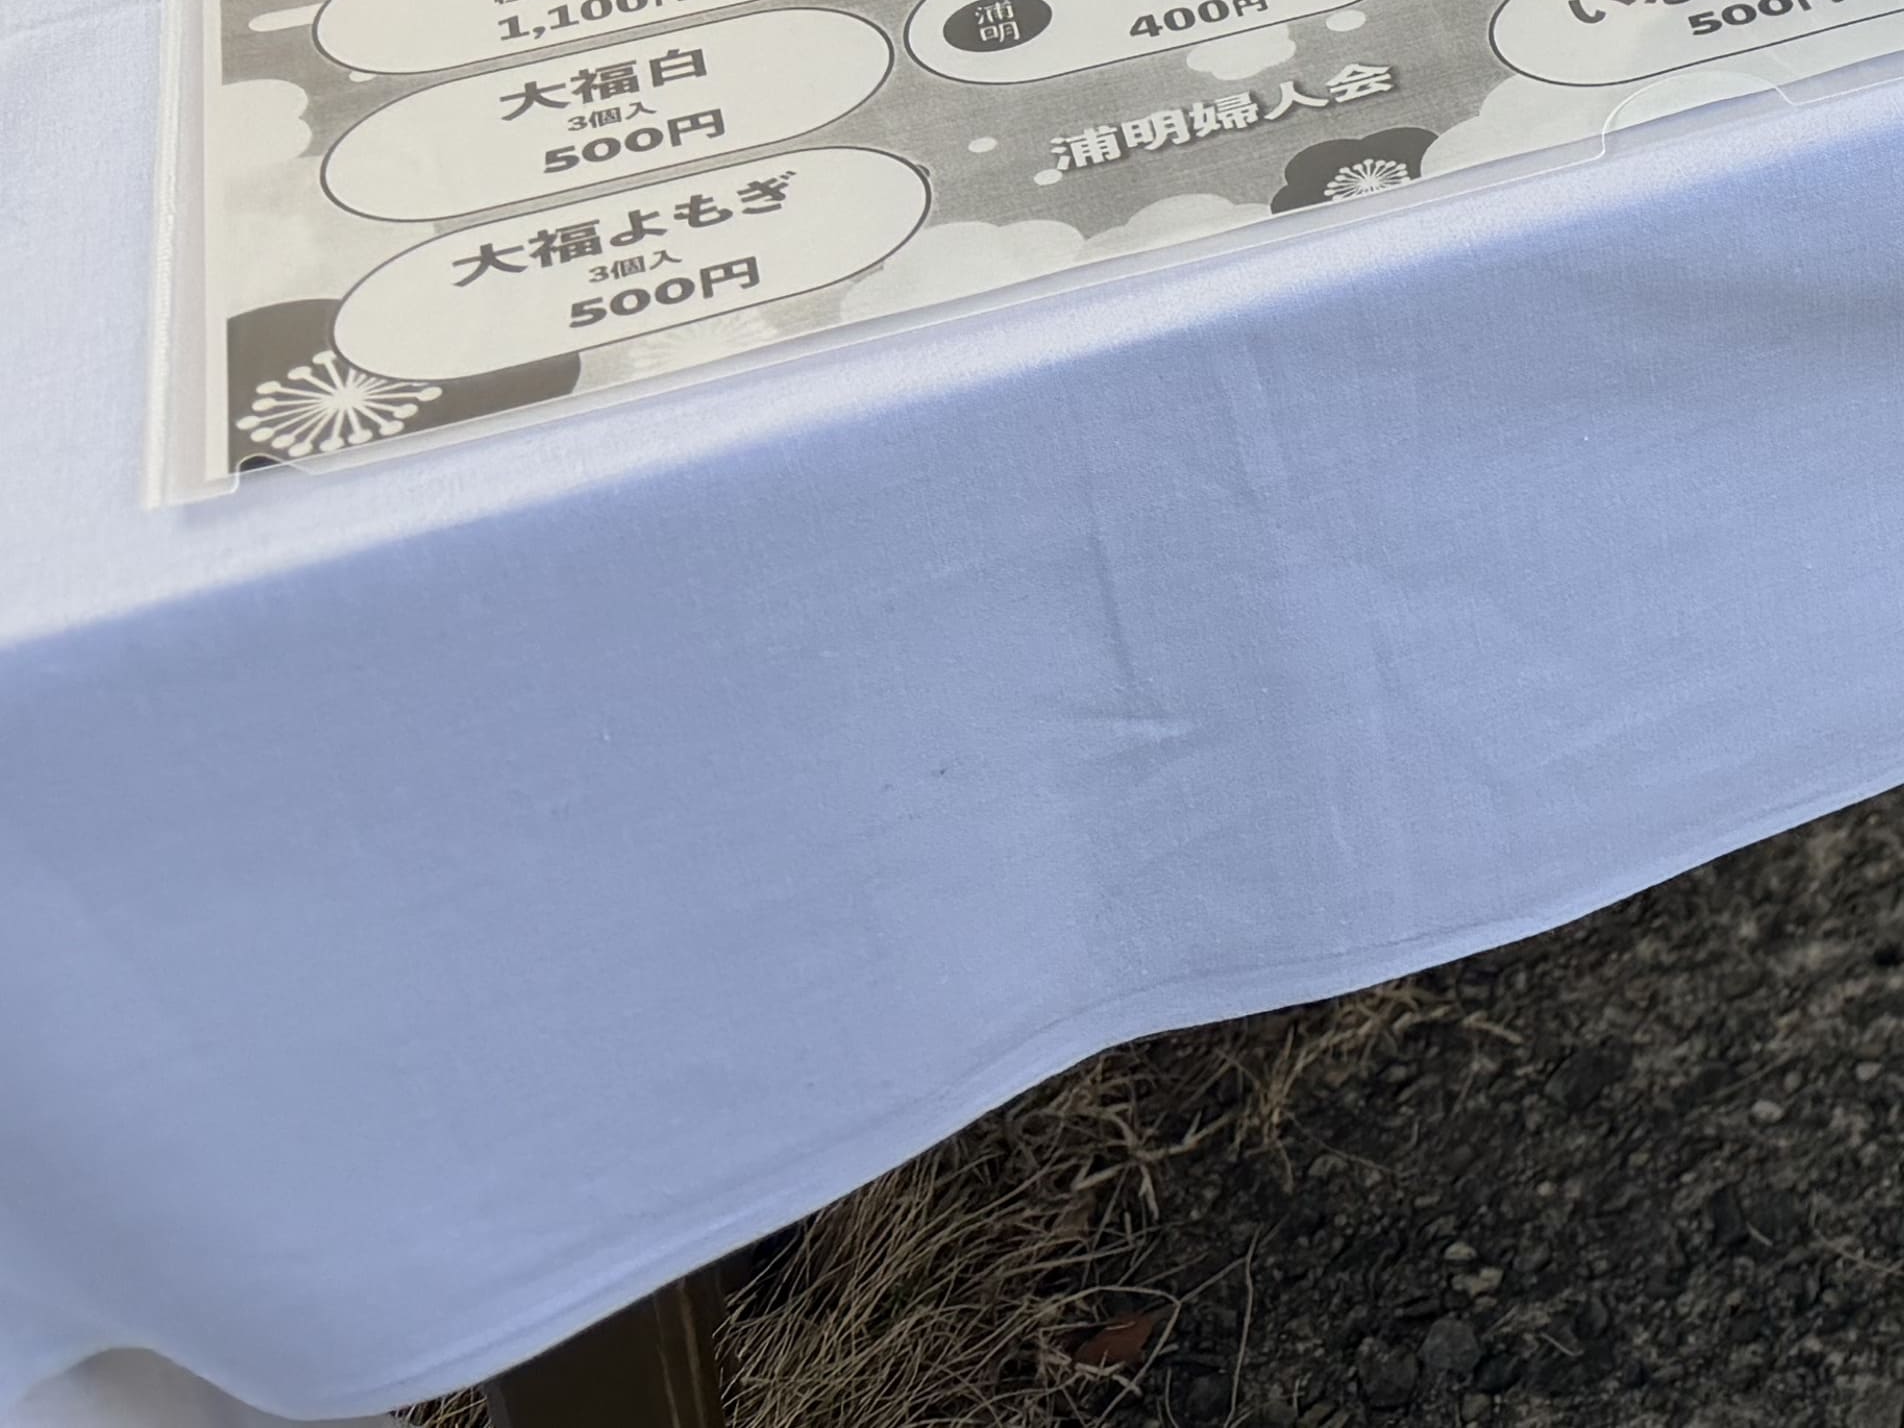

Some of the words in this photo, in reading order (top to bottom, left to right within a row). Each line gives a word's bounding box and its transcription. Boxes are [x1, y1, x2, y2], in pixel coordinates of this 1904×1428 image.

[499, 48, 708, 122] 大福白
[567, 101, 657, 132] 3個入
[1050, 63, 1393, 174] 浦明婦人会
[543, 108, 726, 174] 500円
[451, 170, 797, 288] 大福よもぎ
[588, 249, 683, 283] 3個入
[569, 255, 761, 329] 500円
